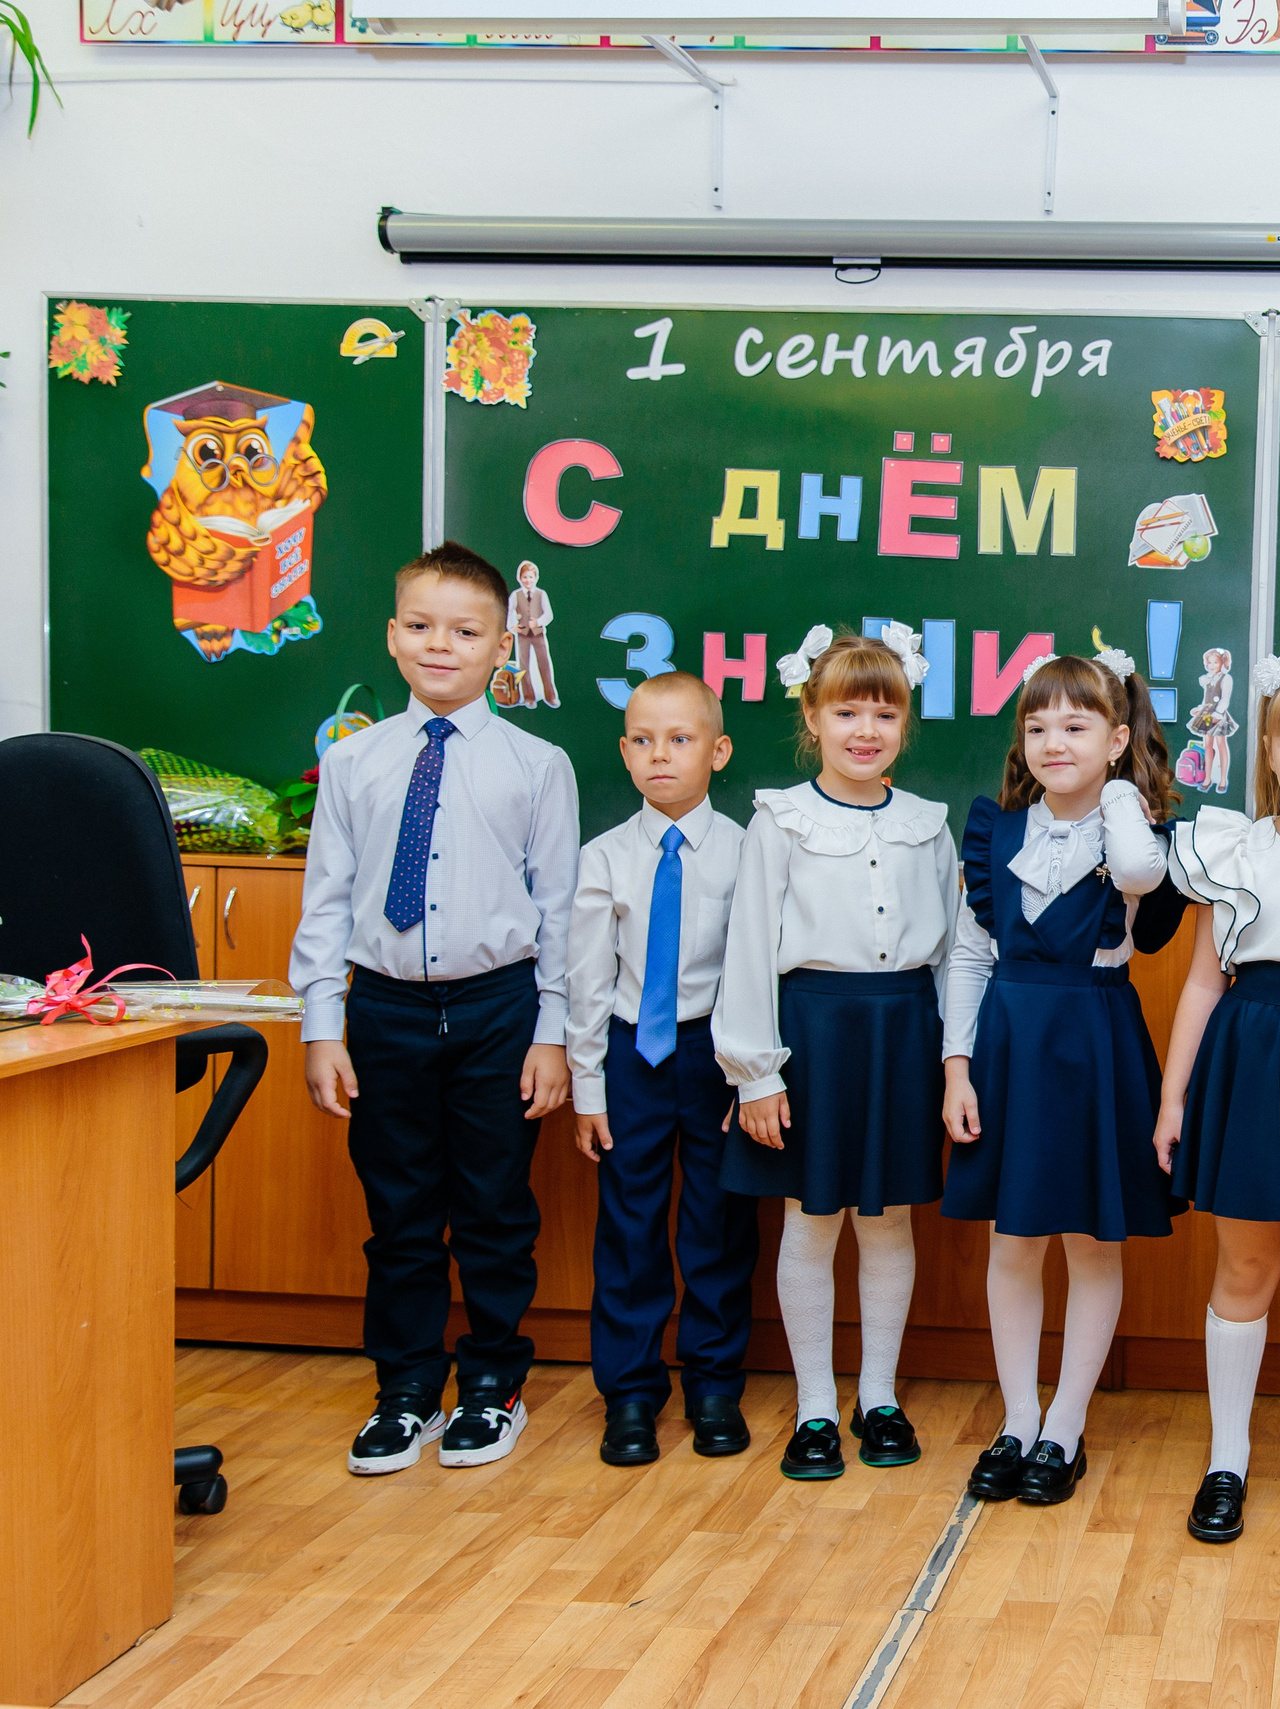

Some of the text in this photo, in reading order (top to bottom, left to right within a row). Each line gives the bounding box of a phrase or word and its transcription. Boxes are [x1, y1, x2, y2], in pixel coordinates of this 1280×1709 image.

[626, 317, 1113, 398] 1 сентября
[523, 438, 623, 547] С
